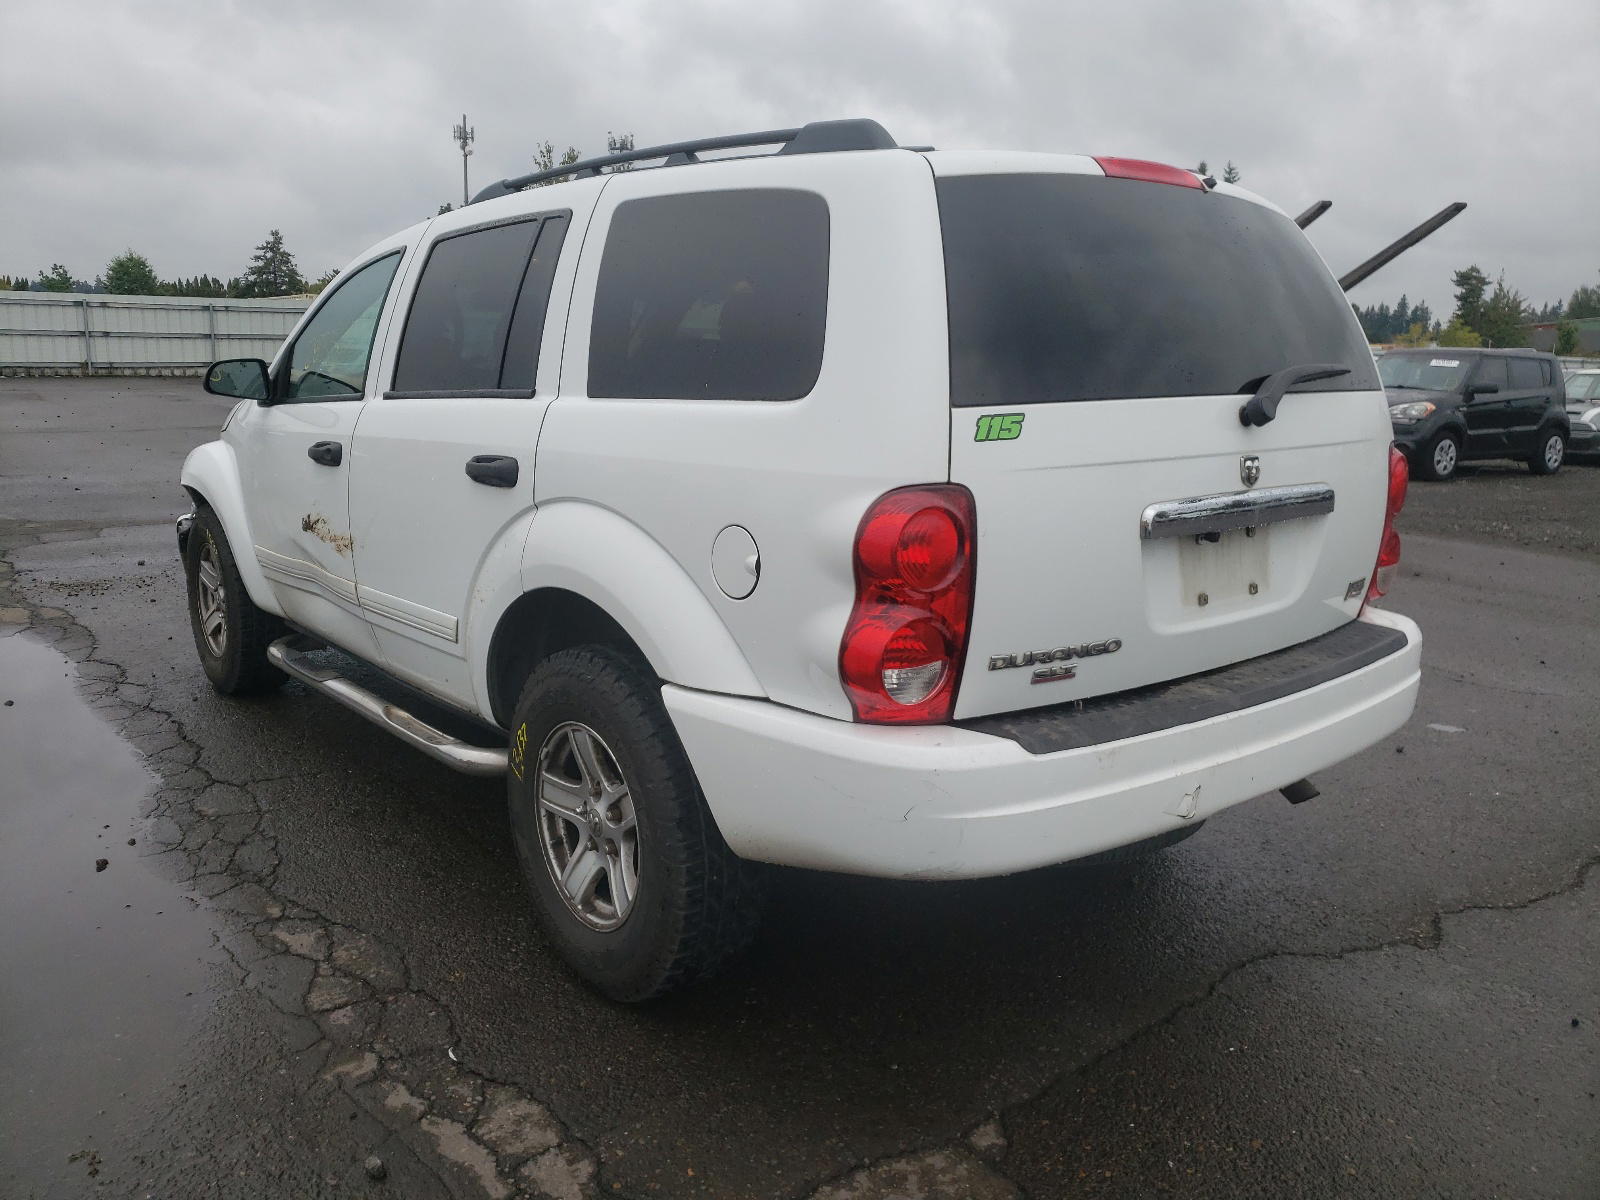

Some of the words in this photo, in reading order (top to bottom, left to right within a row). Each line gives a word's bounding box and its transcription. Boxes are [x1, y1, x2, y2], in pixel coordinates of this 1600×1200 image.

[974, 413, 1025, 442] 115
[988, 638, 1122, 671] DURANGO
[1031, 663, 1078, 683] SLT
